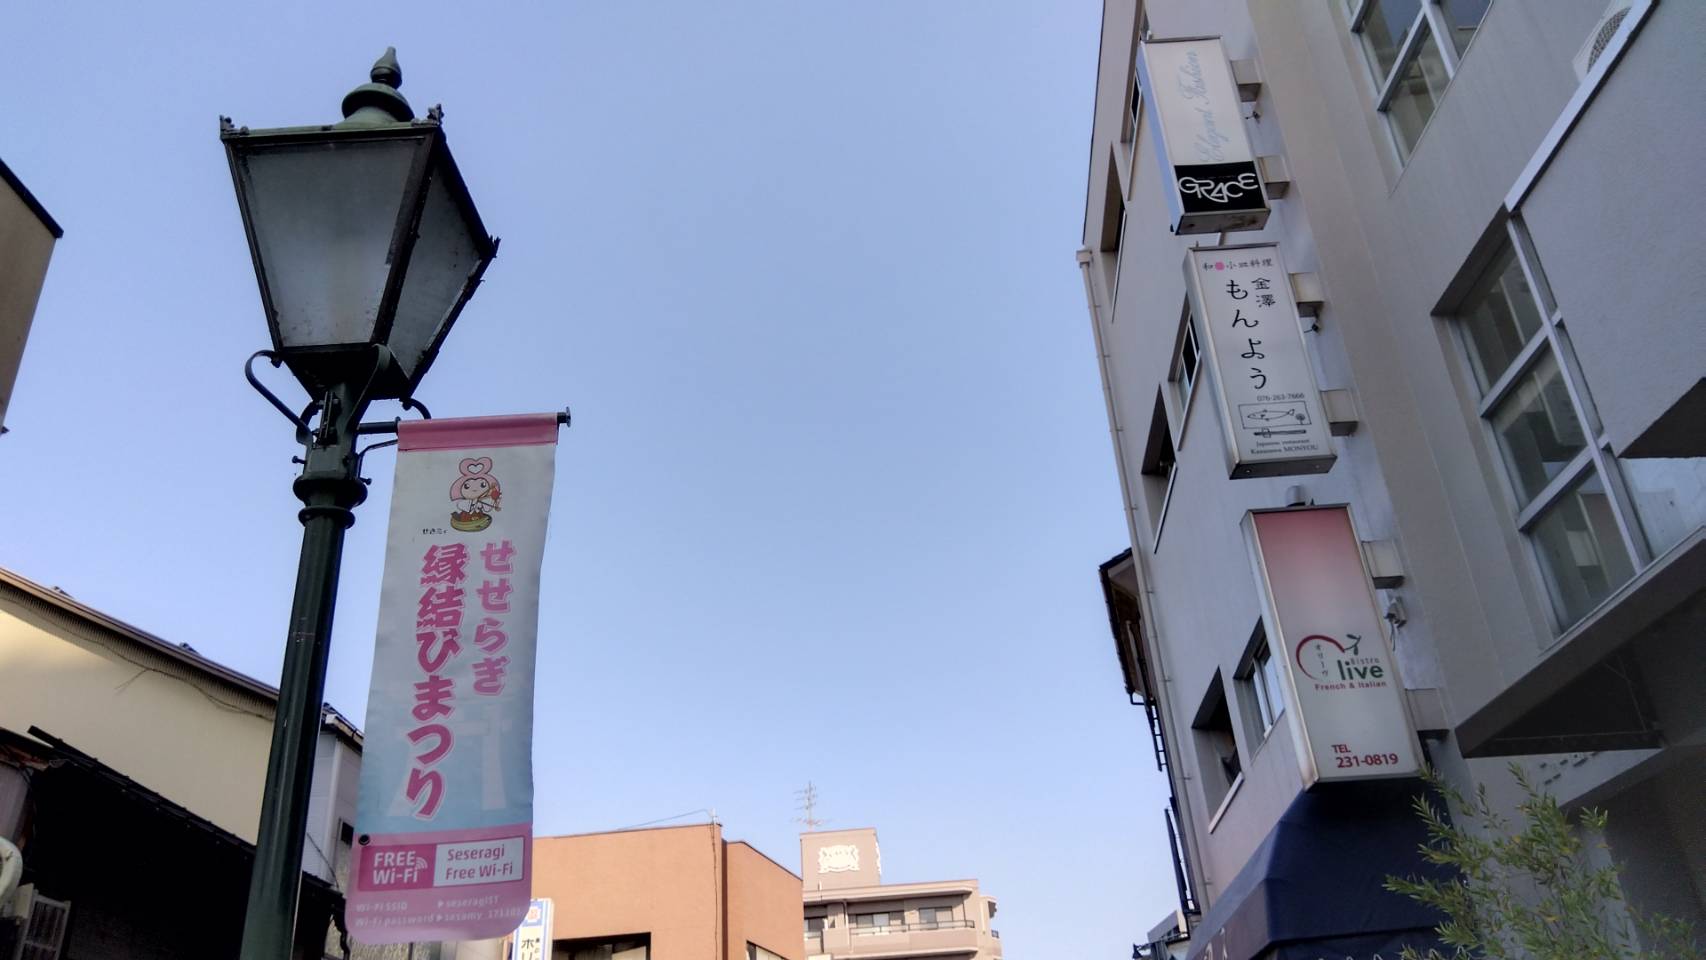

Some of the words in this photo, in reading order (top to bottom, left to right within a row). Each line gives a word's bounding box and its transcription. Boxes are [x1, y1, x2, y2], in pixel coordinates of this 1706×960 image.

[1178, 172, 1259, 203] GRACE
[1251, 277, 1276, 308] 金澤
[1226, 279, 1267, 390] もんよう
[472, 540, 516, 695] せせらぎ
[405, 543, 468, 820] 縁結びまつり
[1315, 683, 1346, 691] French
[1358, 681, 1387, 689] Italian
[1332, 744, 1351, 754] TEL
[1336, 753, 1399, 769] 231-0819
[373, 851, 416, 868] FREE
[447, 844, 505, 862] Seseragi
[373, 867, 419, 885] Wi-Fi
[445, 866, 475, 880] Free
[479, 862, 513, 878] Wi-Fi
